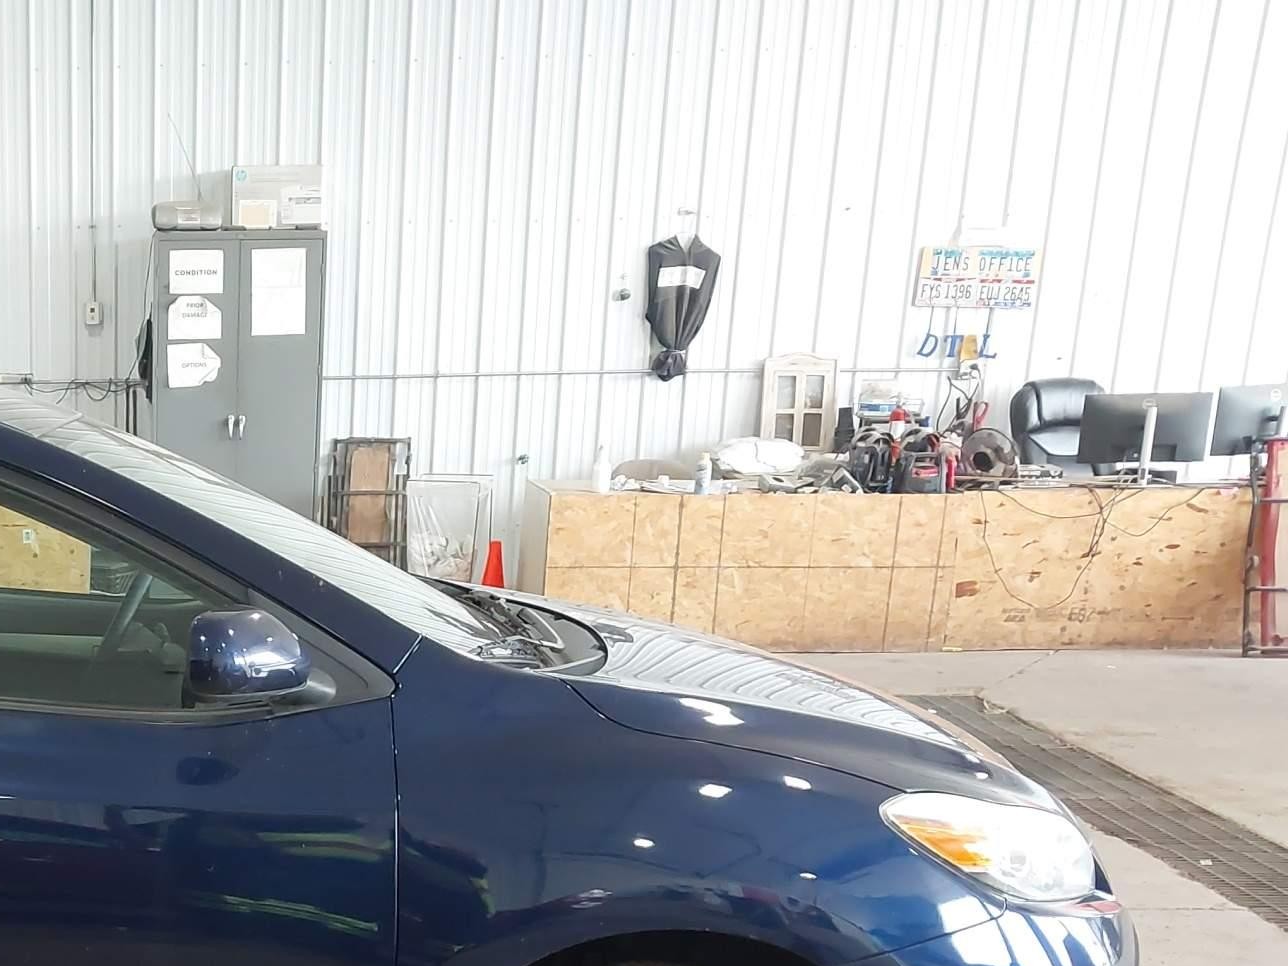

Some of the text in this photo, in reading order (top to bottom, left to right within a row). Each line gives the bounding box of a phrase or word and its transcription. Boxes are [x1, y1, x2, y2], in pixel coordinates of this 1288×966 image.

[174, 268, 218, 276] CONDITION
[933, 256, 1033, 273] JENS OFFICE
[943, 284, 973, 300] 1396
[979, 285, 1001, 301] EUJ
